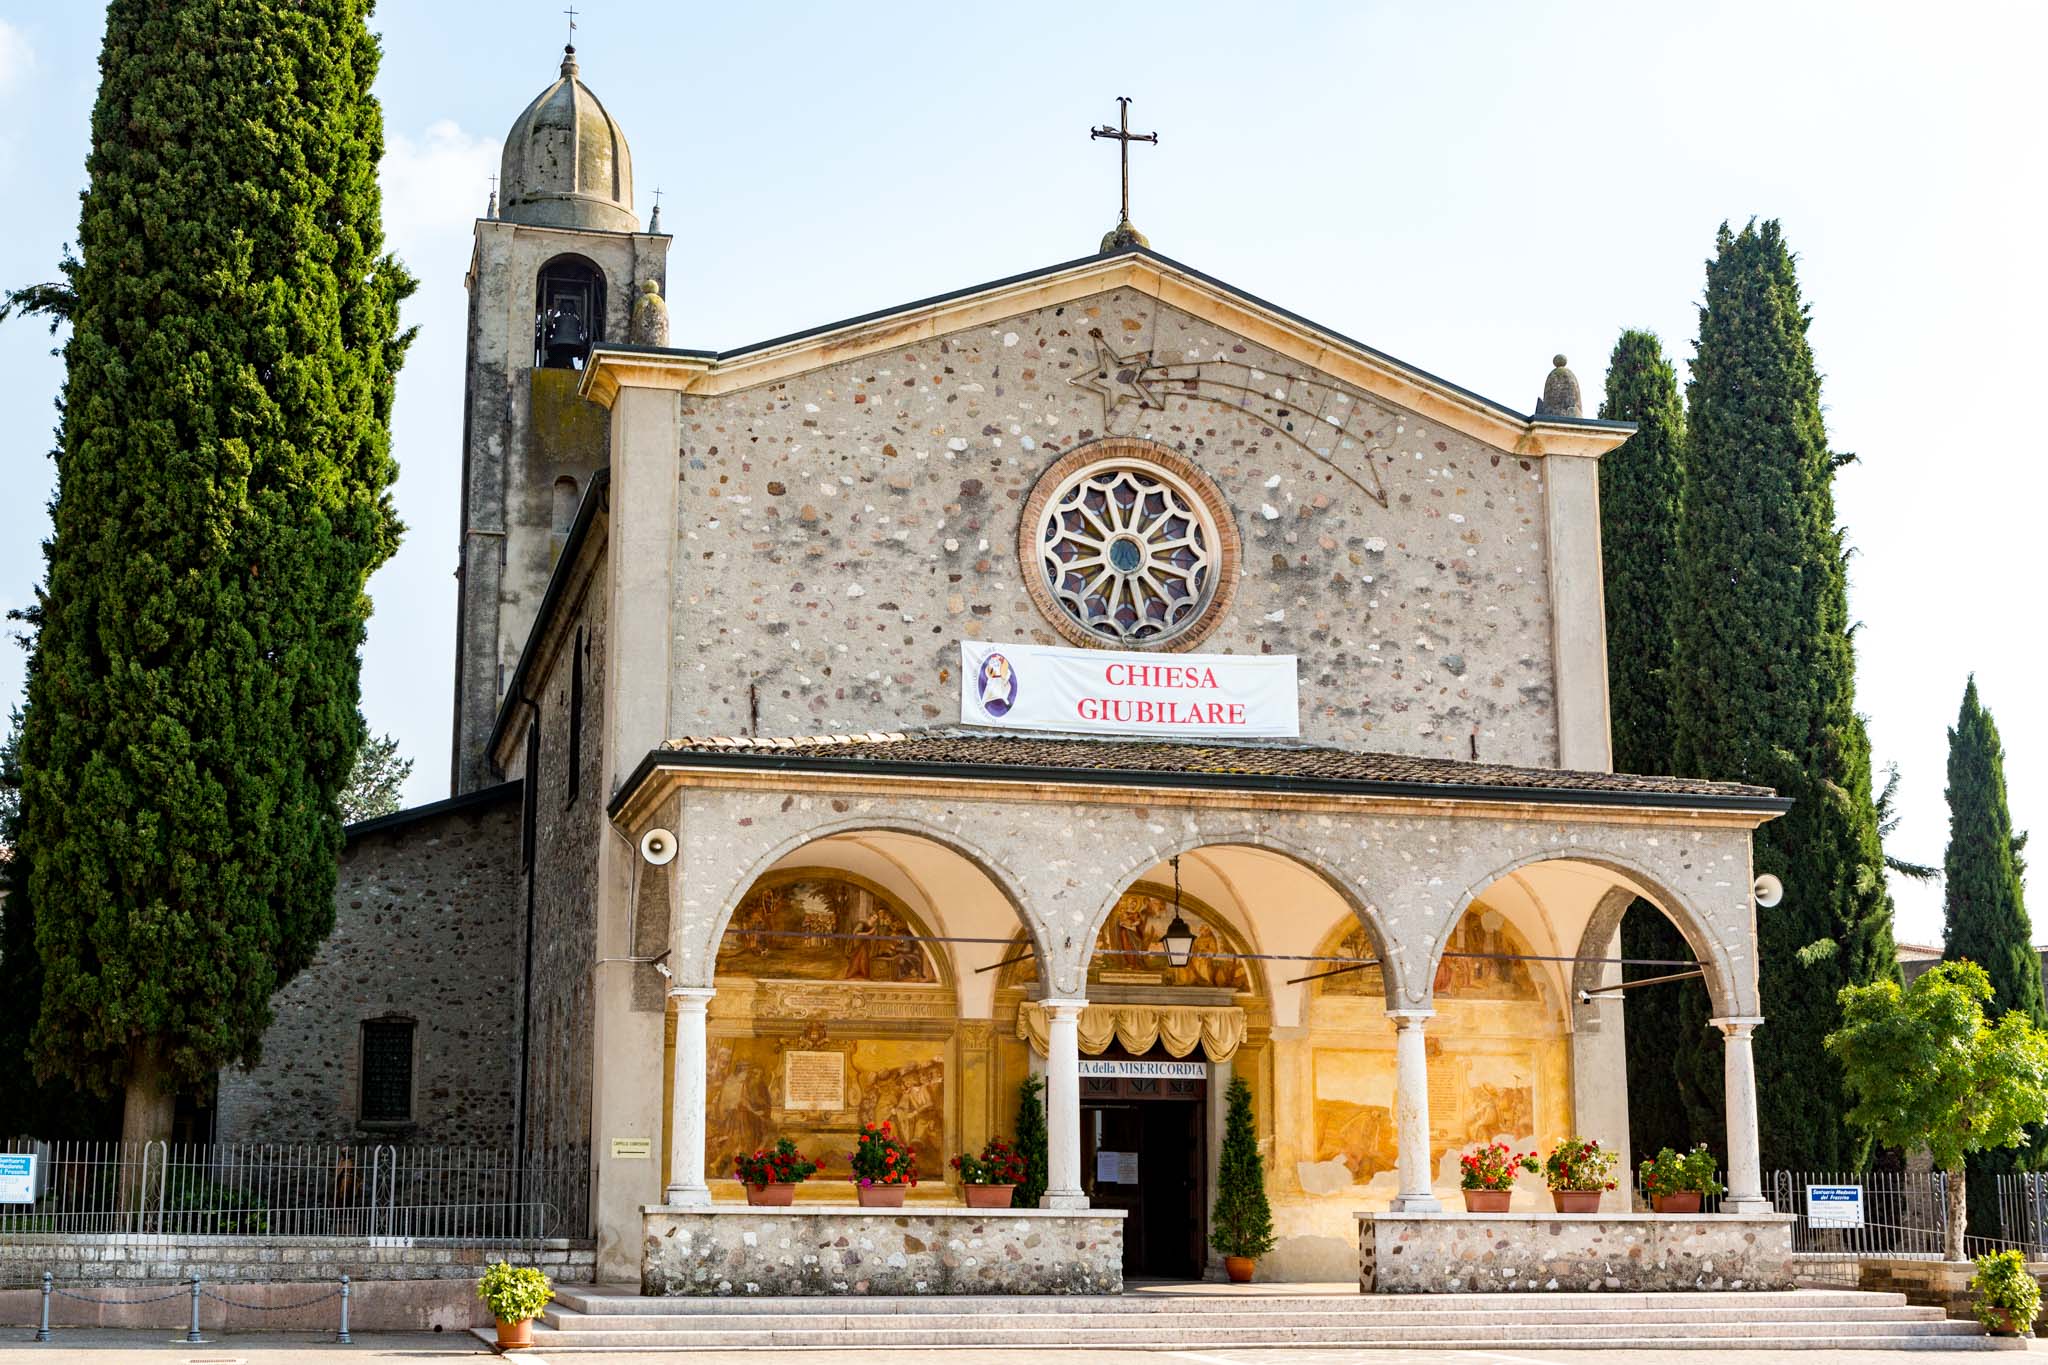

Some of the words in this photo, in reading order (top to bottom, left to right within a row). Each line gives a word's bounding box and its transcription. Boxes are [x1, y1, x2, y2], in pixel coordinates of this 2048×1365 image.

[1105, 664, 1219, 689] CHIESA
[1077, 698, 1247, 725] GIUBILARE
[1092, 1062, 1116, 1074] della
[1119, 1062, 1204, 1076] MISERICORDIA
